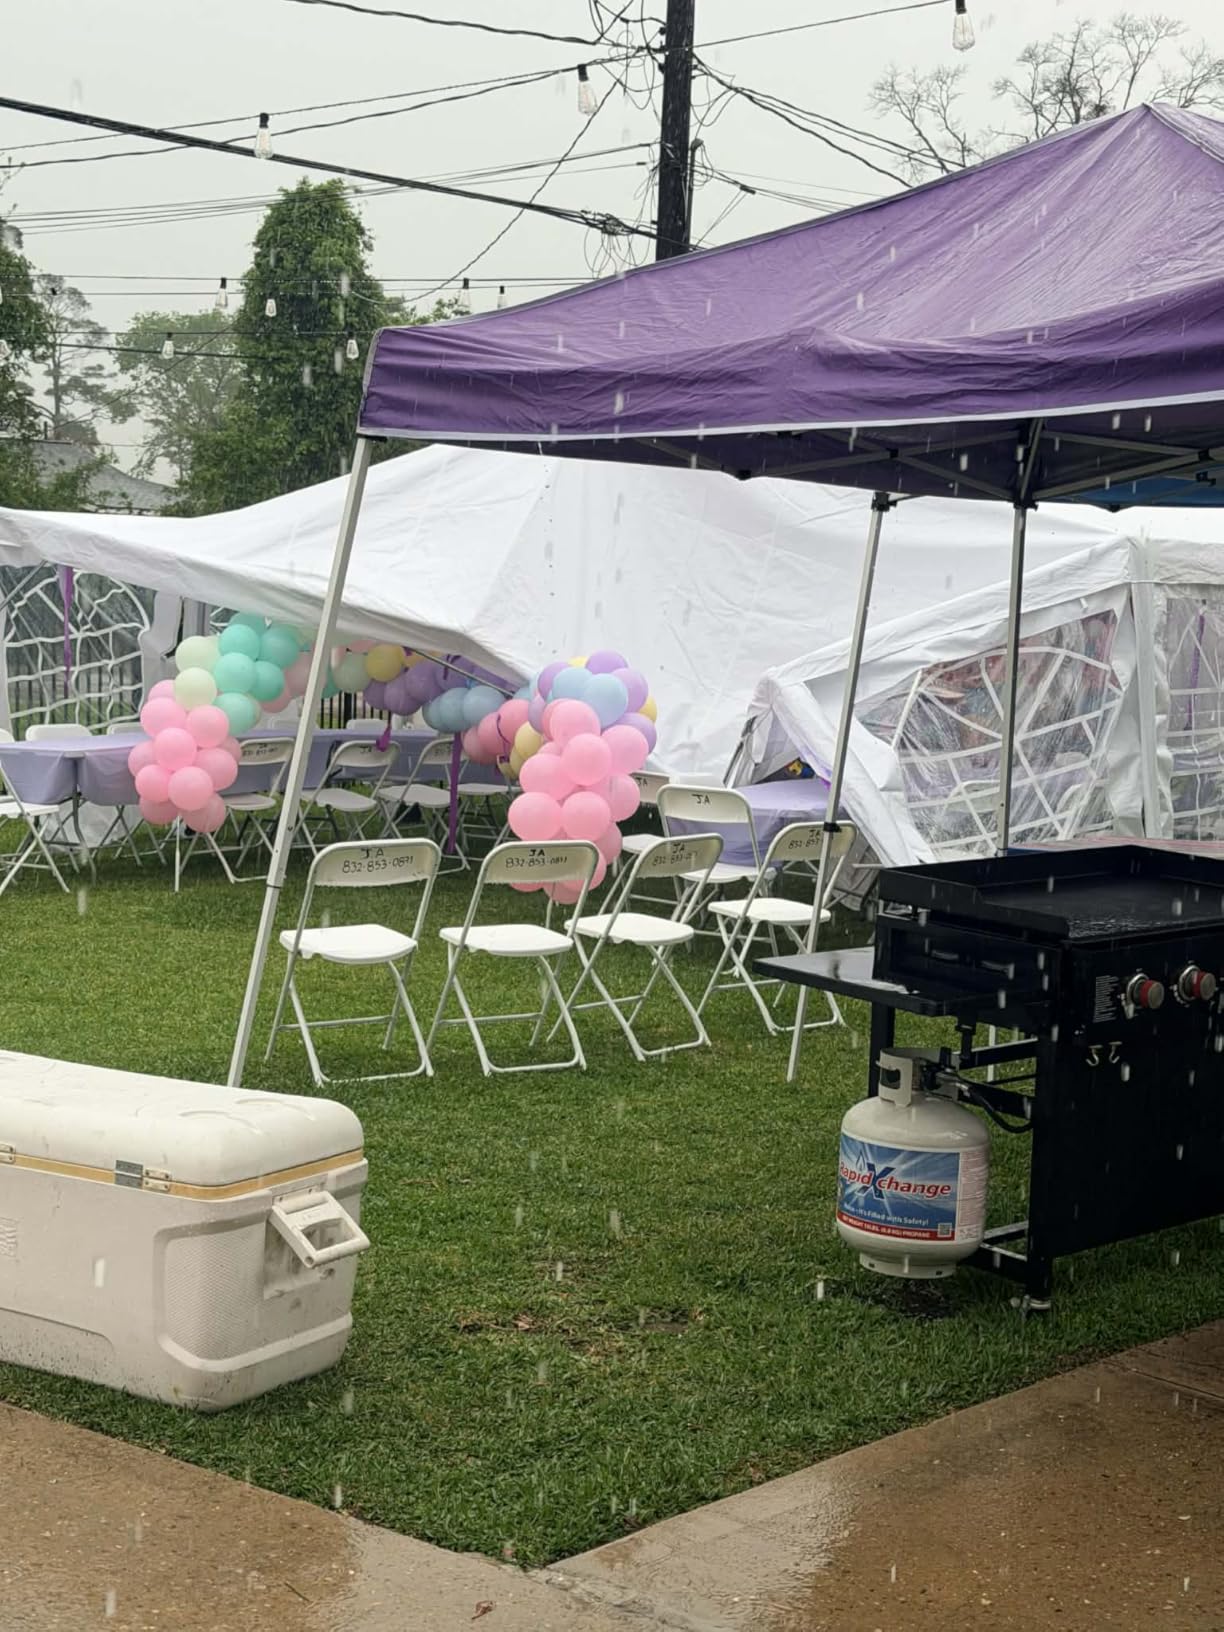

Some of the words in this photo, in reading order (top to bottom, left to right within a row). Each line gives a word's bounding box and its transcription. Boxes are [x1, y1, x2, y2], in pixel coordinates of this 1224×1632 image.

[692, 793, 711, 805] JA
[528, 848, 546, 857] JA
[672, 842, 685, 854] JA
